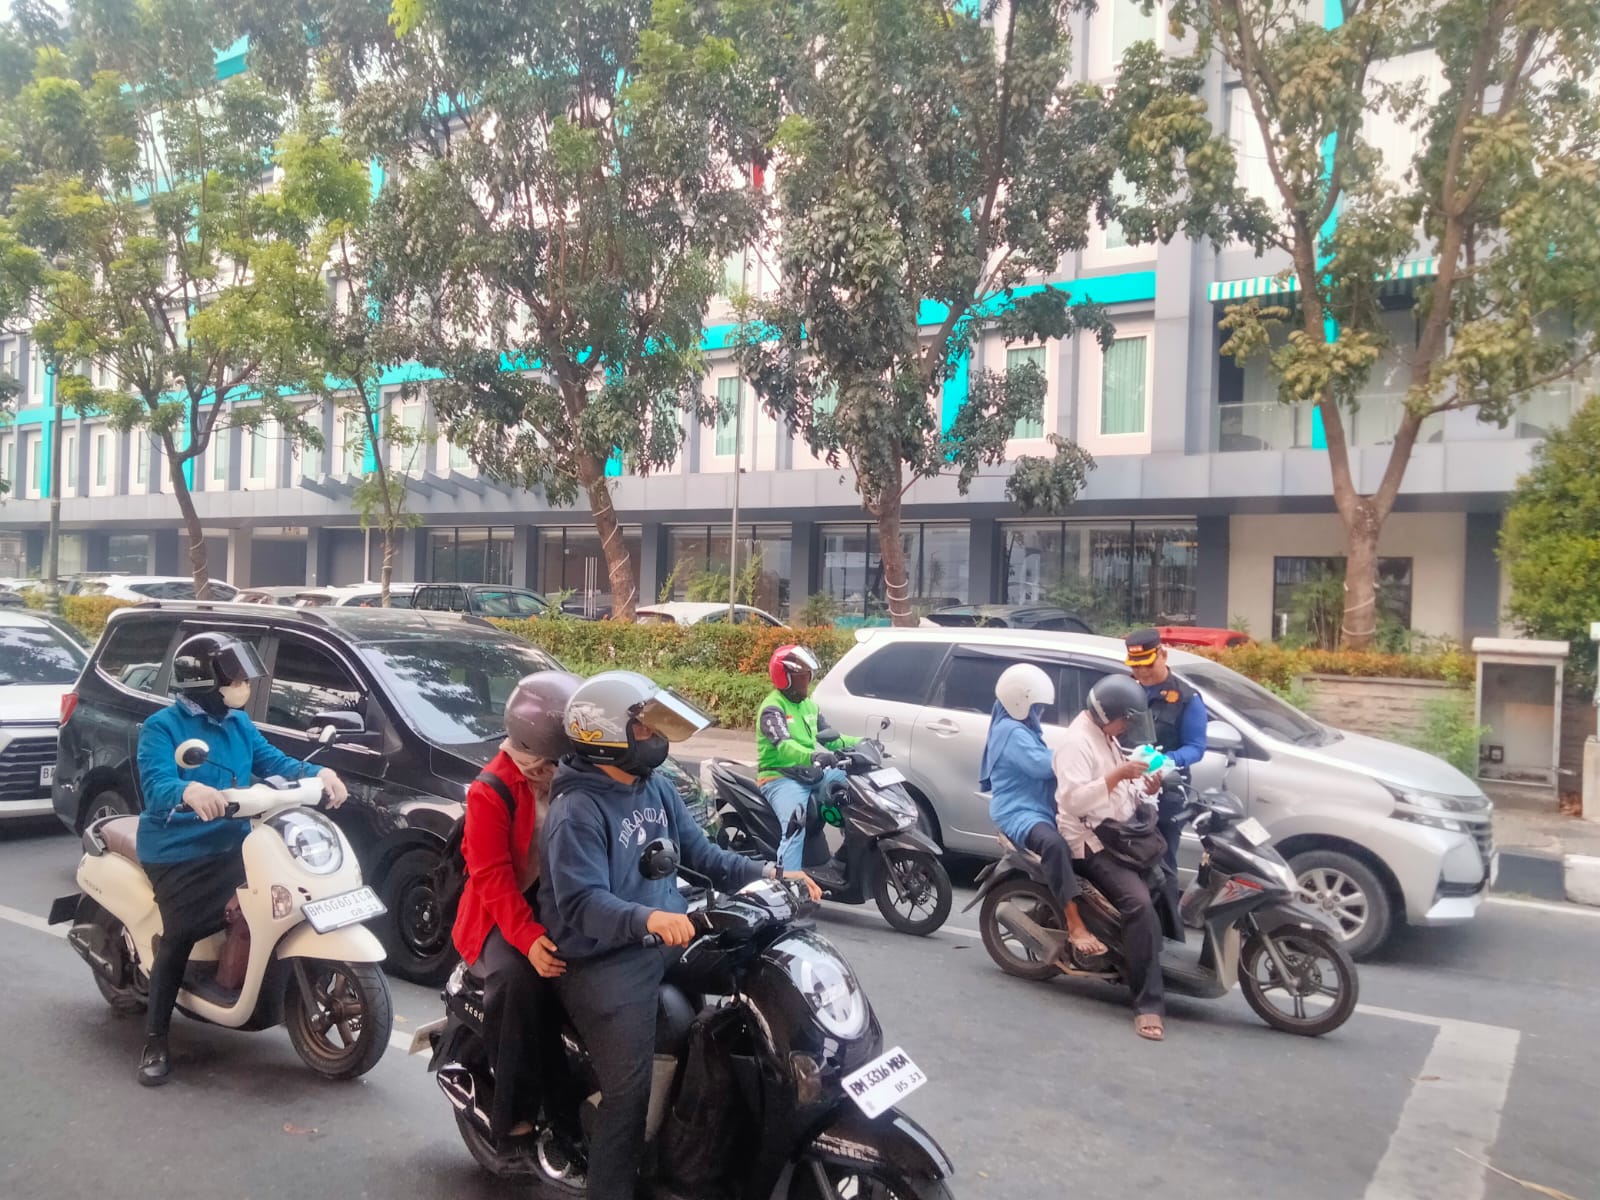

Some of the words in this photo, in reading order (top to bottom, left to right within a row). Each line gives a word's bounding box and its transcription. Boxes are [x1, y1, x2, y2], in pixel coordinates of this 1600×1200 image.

[306, 904, 325, 917] BM
[849, 1079, 870, 1097] BM
[864, 1065, 891, 1087] 3316
